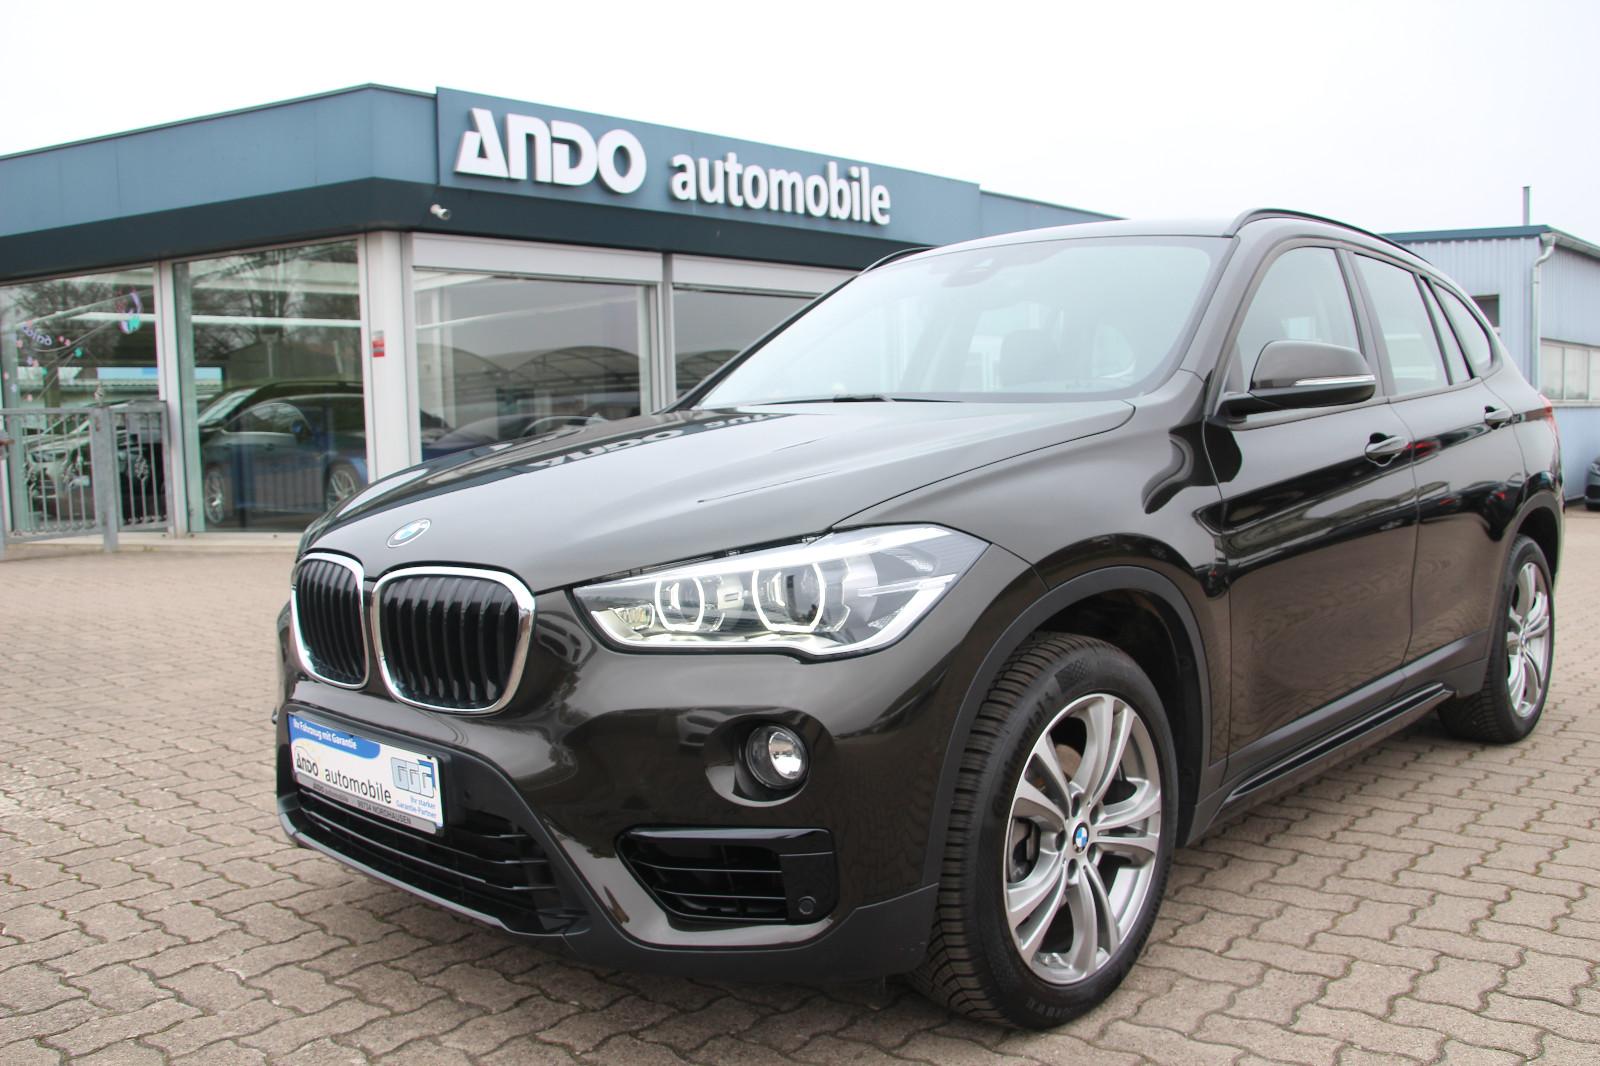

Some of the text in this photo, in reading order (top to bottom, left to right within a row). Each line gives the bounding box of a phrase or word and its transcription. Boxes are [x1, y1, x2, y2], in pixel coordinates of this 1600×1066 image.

[454, 107, 891, 225] ANDO automobile
[322, 730, 332, 742] mit
[332, 733, 358, 750] Garantie
[297, 753, 319, 777] ANDO
[325, 768, 392, 805] automobile
[372, 805, 412, 825] NORDHAUSEN
